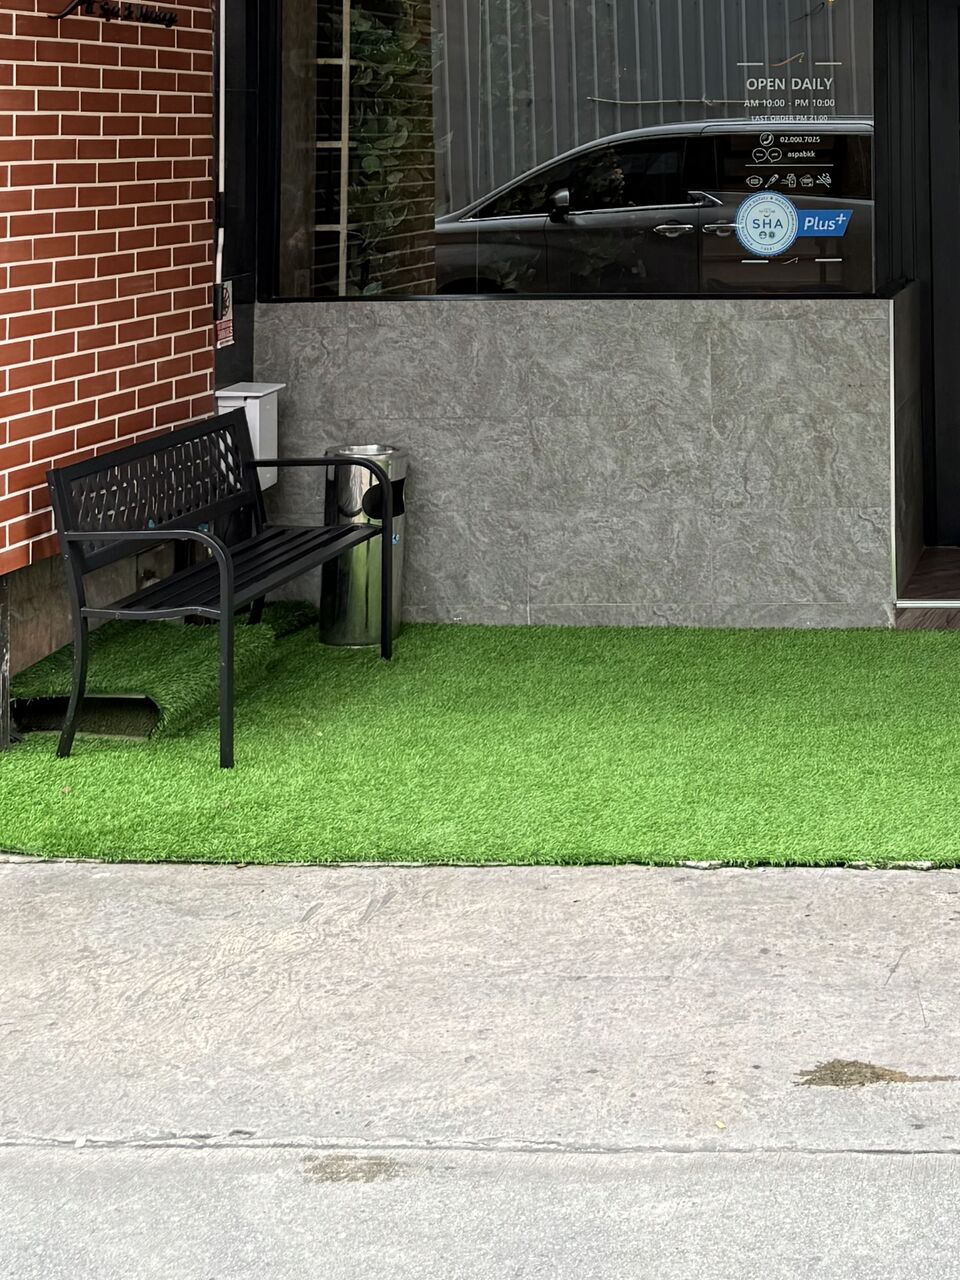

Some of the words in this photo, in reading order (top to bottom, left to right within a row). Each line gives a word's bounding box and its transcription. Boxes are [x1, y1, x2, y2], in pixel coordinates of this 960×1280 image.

[746, 78, 786, 90] OPEN
[791, 78, 833, 90] DAILY
[744, 99, 759, 107] AM
[762, 99, 785, 107] 10:00
[794, 99, 809, 107] PM
[812, 99, 836, 107] 10:00
[752, 218, 784, 230] SHA
